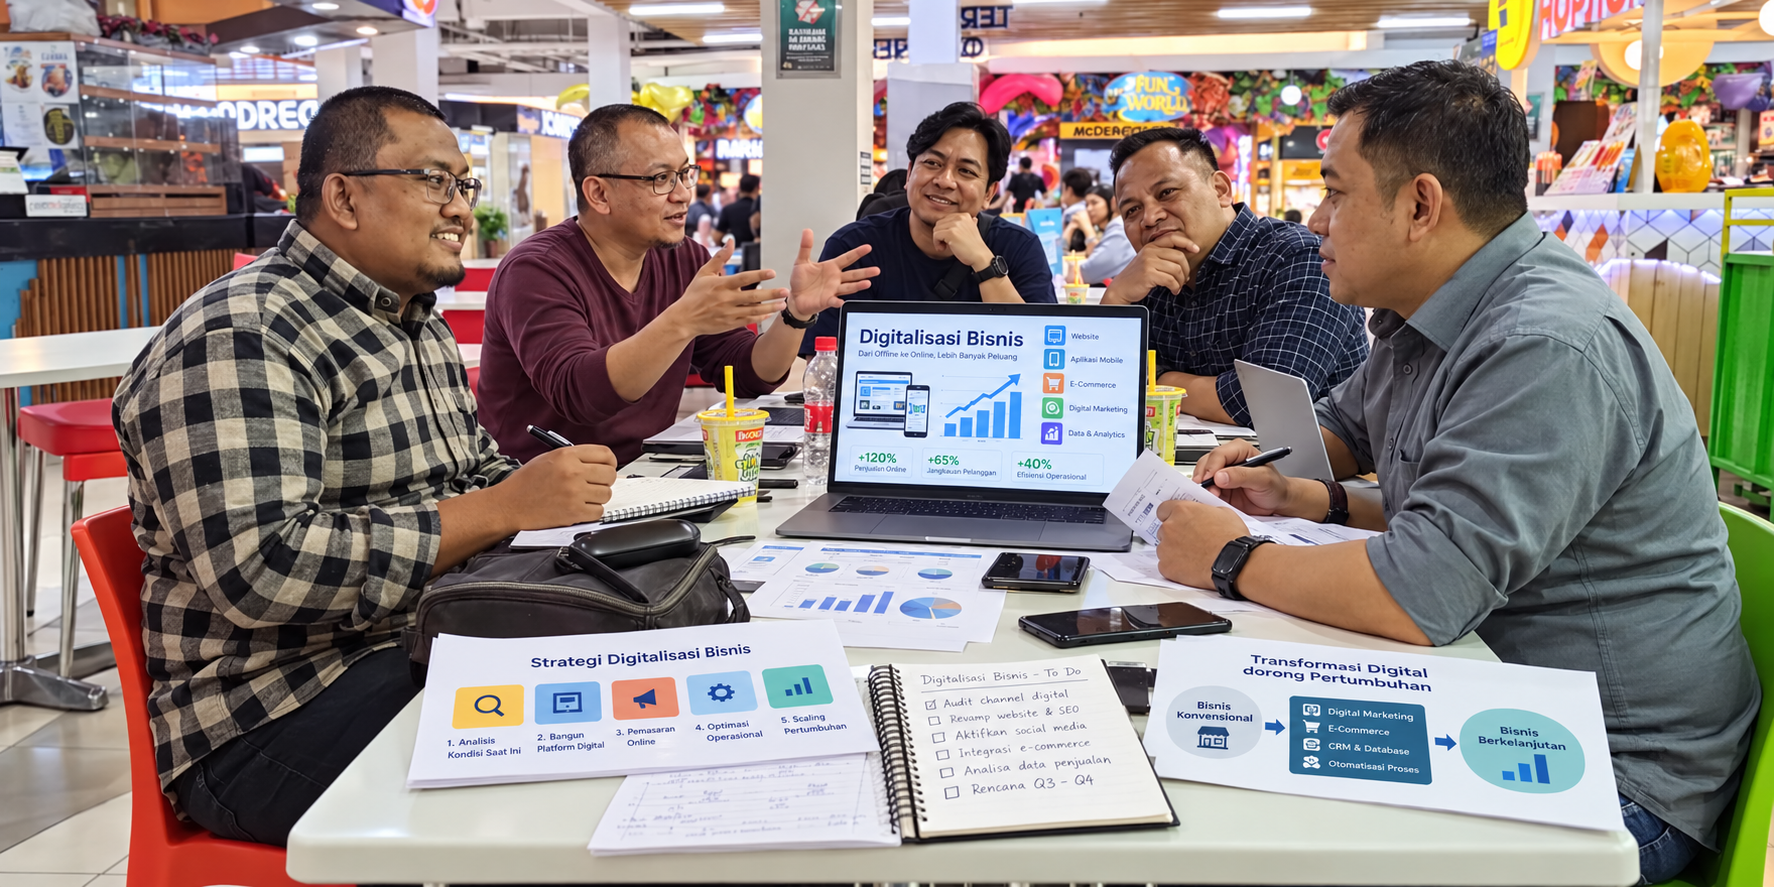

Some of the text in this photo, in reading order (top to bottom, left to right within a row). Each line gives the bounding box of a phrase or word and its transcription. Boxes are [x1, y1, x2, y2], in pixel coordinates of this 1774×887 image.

[1135, 74, 1181, 95] FUN
[1125, 93, 1188, 115] WORLD
[860, 328, 1024, 348] Digitalisasi Bisnis
[858, 350, 873, 358] Dari
[874, 350, 898, 358] Offline
[910, 351, 936, 359] Online,
[959, 352, 986, 361] Banyak
[988, 353, 1018, 362] Peluang
[1070, 356, 1098, 364] Aplikasi
[1070, 380, 1116, 388] E-Commerce
[1069, 405, 1128, 414] Digital Marketing
[1093, 430, 1126, 439] Analytics
[858, 452, 897, 464] +120%
[928, 455, 960, 466] +65%
[1018, 458, 1052, 470] +40%
[1017, 471, 1086, 480] Efisiensi Operasional
[530, 643, 752, 670] Strategi Digitalisasi Bisnis
[1250, 654, 1428, 680] Transformasi Digital
[920, 674, 986, 687] Digitalisasi
[994, 672, 1028, 681] Bisnis
[1044, 668, 1058, 678] To
[1064, 667, 1082, 676] Do
[1242, 664, 1432, 694] dorong Pertumbuhan
[943, 689, 1069, 708] Audit channel digital
[1197, 700, 1232, 712] Bisnis
[781, 713, 826, 724] 5. Scaling
[950, 705, 1080, 724] Revamp website & SEO
[1176, 710, 1254, 723] Konvensional
[1328, 708, 1414, 722] Digital Marketing
[628, 726, 676, 736] Pemasaran
[707, 720, 750, 732] Optimasi
[784, 722, 848, 735] Pertumbuhan
[956, 722, 1088, 740] Aktifkan social media
[1328, 724, 1390, 736] E-Commerce
[1500, 726, 1540, 738] Bisnis
[458, 737, 496, 746] Analisis
[537, 732, 584, 742] 2. Bangun
[706, 730, 764, 742] Operasional
[537, 742, 605, 753] Platform Digital
[627, 738, 656, 747] Online
[1478, 734, 1566, 752] Berkelanjutan
[448, 747, 522, 759] Kondisi Saat Ini
[958, 740, 1092, 759] Integrasi e-commerce
[1328, 742, 1410, 756] CRM & Database
[964, 755, 1112, 776] Analisa data penjualan
[1328, 760, 1420, 774] Otomatisasi Proses
[972, 782, 1026, 795] Rencana
[1034, 778, 1056, 790] Q3
[1074, 774, 1094, 786] Q4
